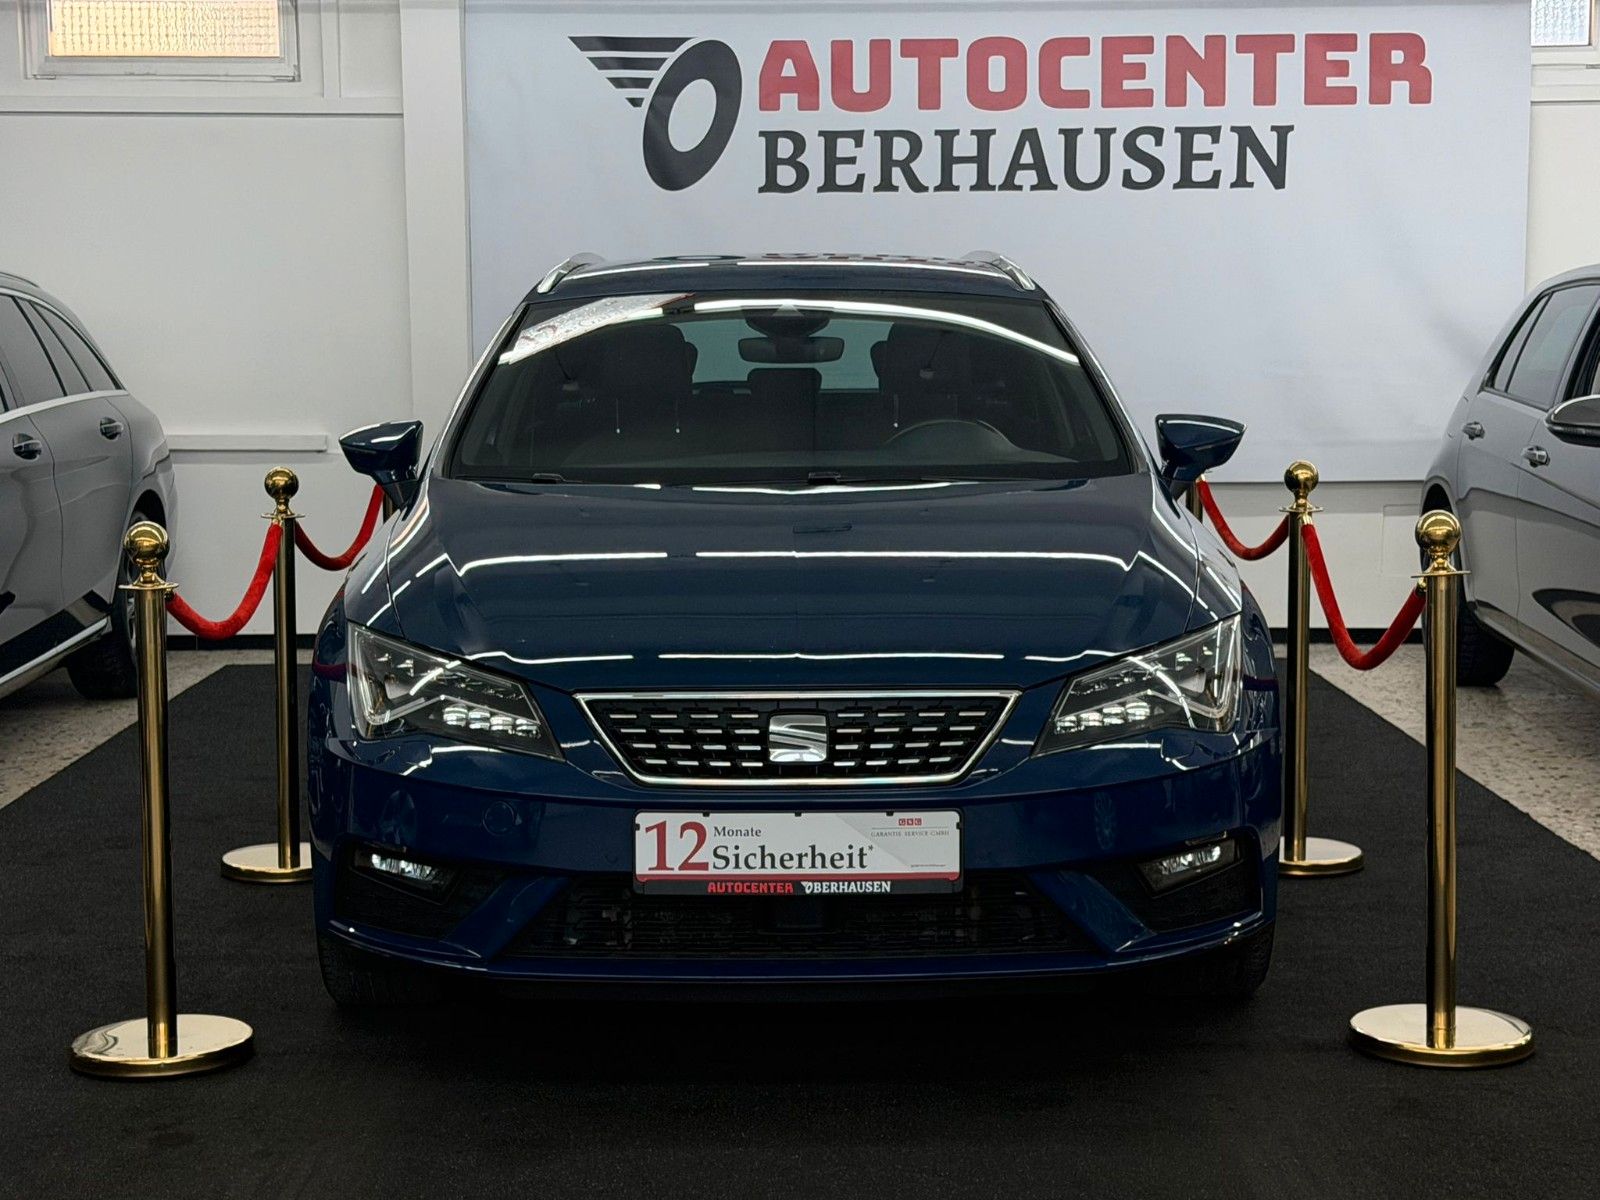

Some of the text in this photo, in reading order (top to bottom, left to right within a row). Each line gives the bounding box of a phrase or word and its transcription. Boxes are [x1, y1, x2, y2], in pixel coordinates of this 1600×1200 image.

[757, 32, 1433, 112] AUTOCENTER
[645, 820, 709, 871] 12
[713, 826, 762, 837] Monate
[707, 882, 793, 893] AUTOCENTER
